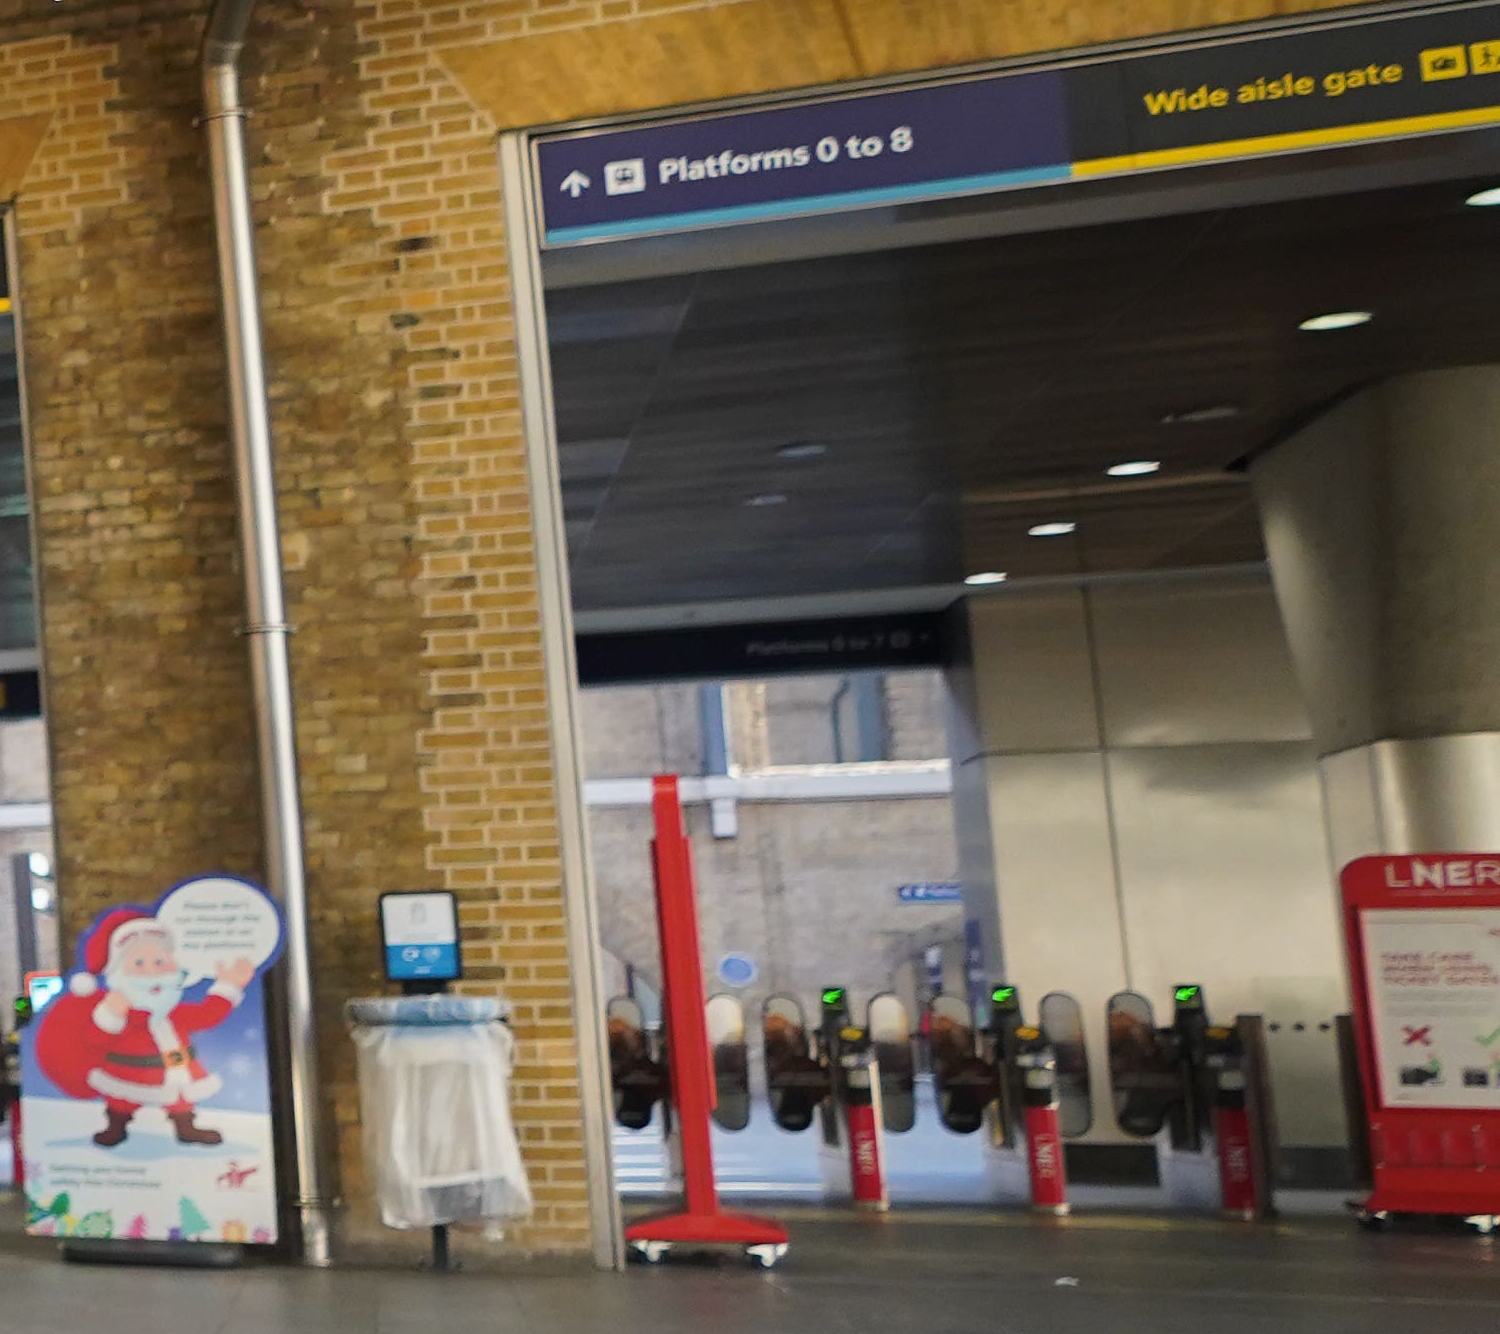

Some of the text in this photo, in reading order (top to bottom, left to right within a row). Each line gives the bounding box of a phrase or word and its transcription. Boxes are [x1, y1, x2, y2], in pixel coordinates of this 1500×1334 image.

[1143, 62, 1404, 115] Wide aisle gate
[658, 125, 914, 185] Platforms 0 to 8
